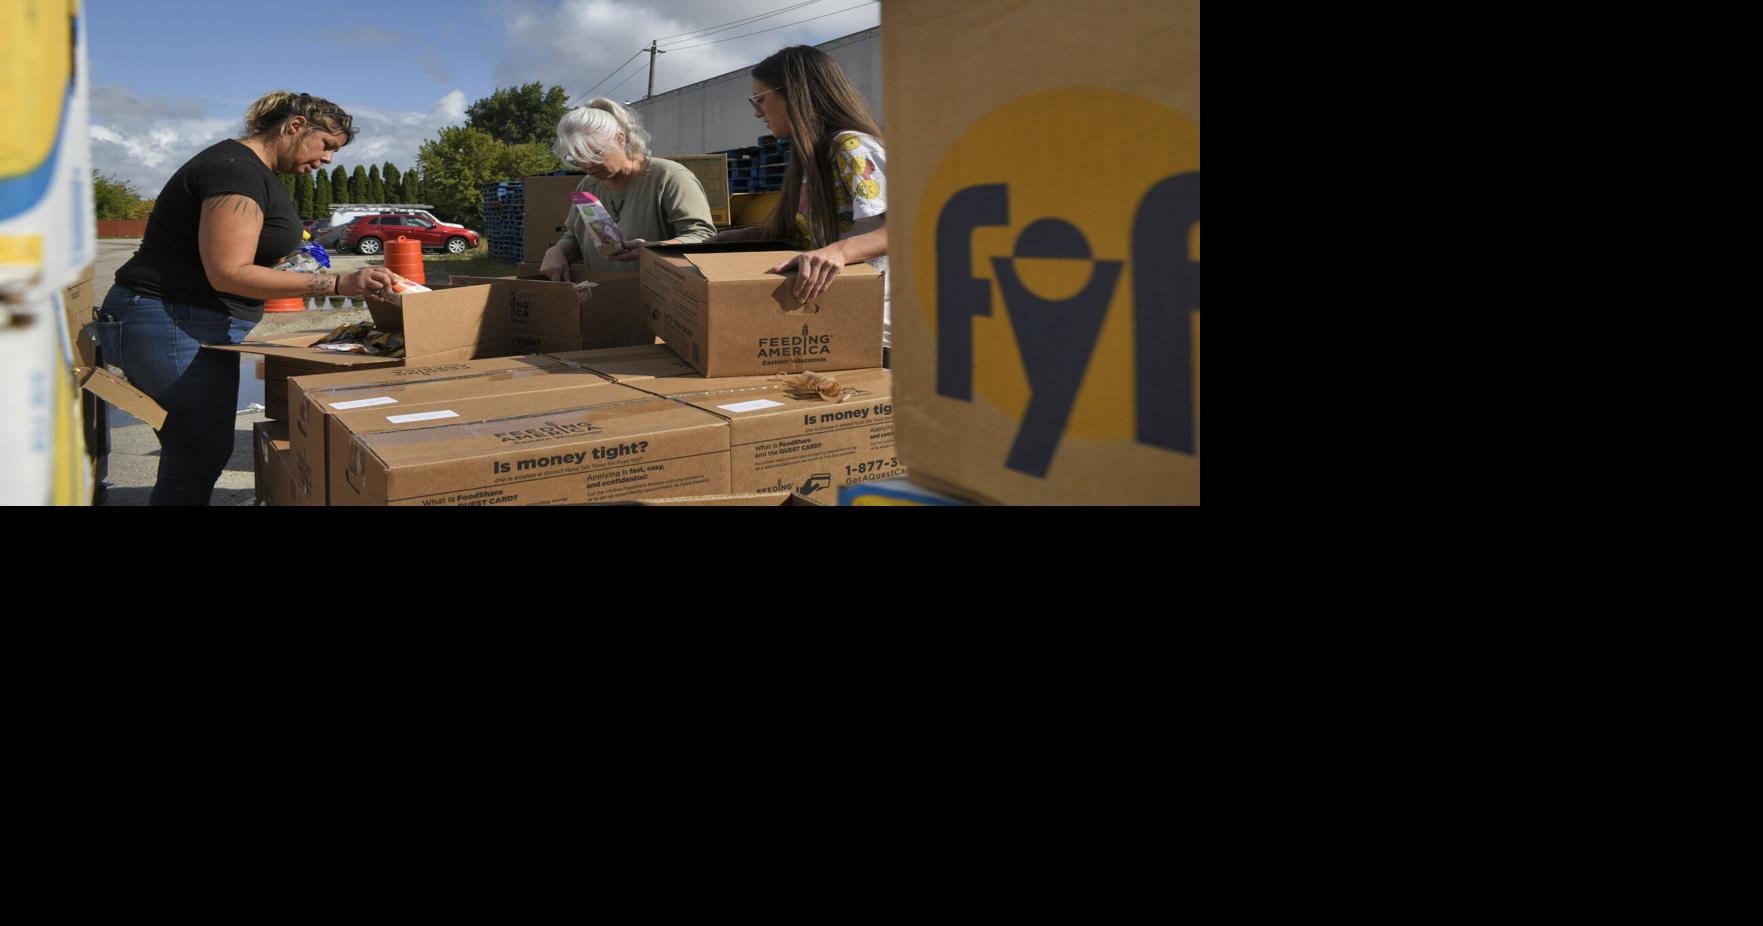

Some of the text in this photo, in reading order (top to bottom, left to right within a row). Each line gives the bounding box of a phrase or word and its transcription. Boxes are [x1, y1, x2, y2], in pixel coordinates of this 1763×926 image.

[759, 334, 831, 348] FEEDING
[757, 345, 831, 358] AMERICA
[790, 356, 827, 364] Wisconsin
[804, 415, 817, 425] Is
[820, 407, 870, 423] money
[755, 443, 772, 451] What
[778, 438, 812, 447] FoodShare
[779, 446, 800, 454] QUEST
[801, 442, 822, 452] CARD?
[493, 441, 649, 474] Is money tight?
[587, 467, 621, 481] Applying
[629, 466, 645, 475] fast,
[587, 481, 601, 489] and
[602, 474, 649, 487] confidential!
[422, 496, 446, 506] What
[457, 489, 504, 501] FoodShare
[489, 494, 519, 505] CARD?
